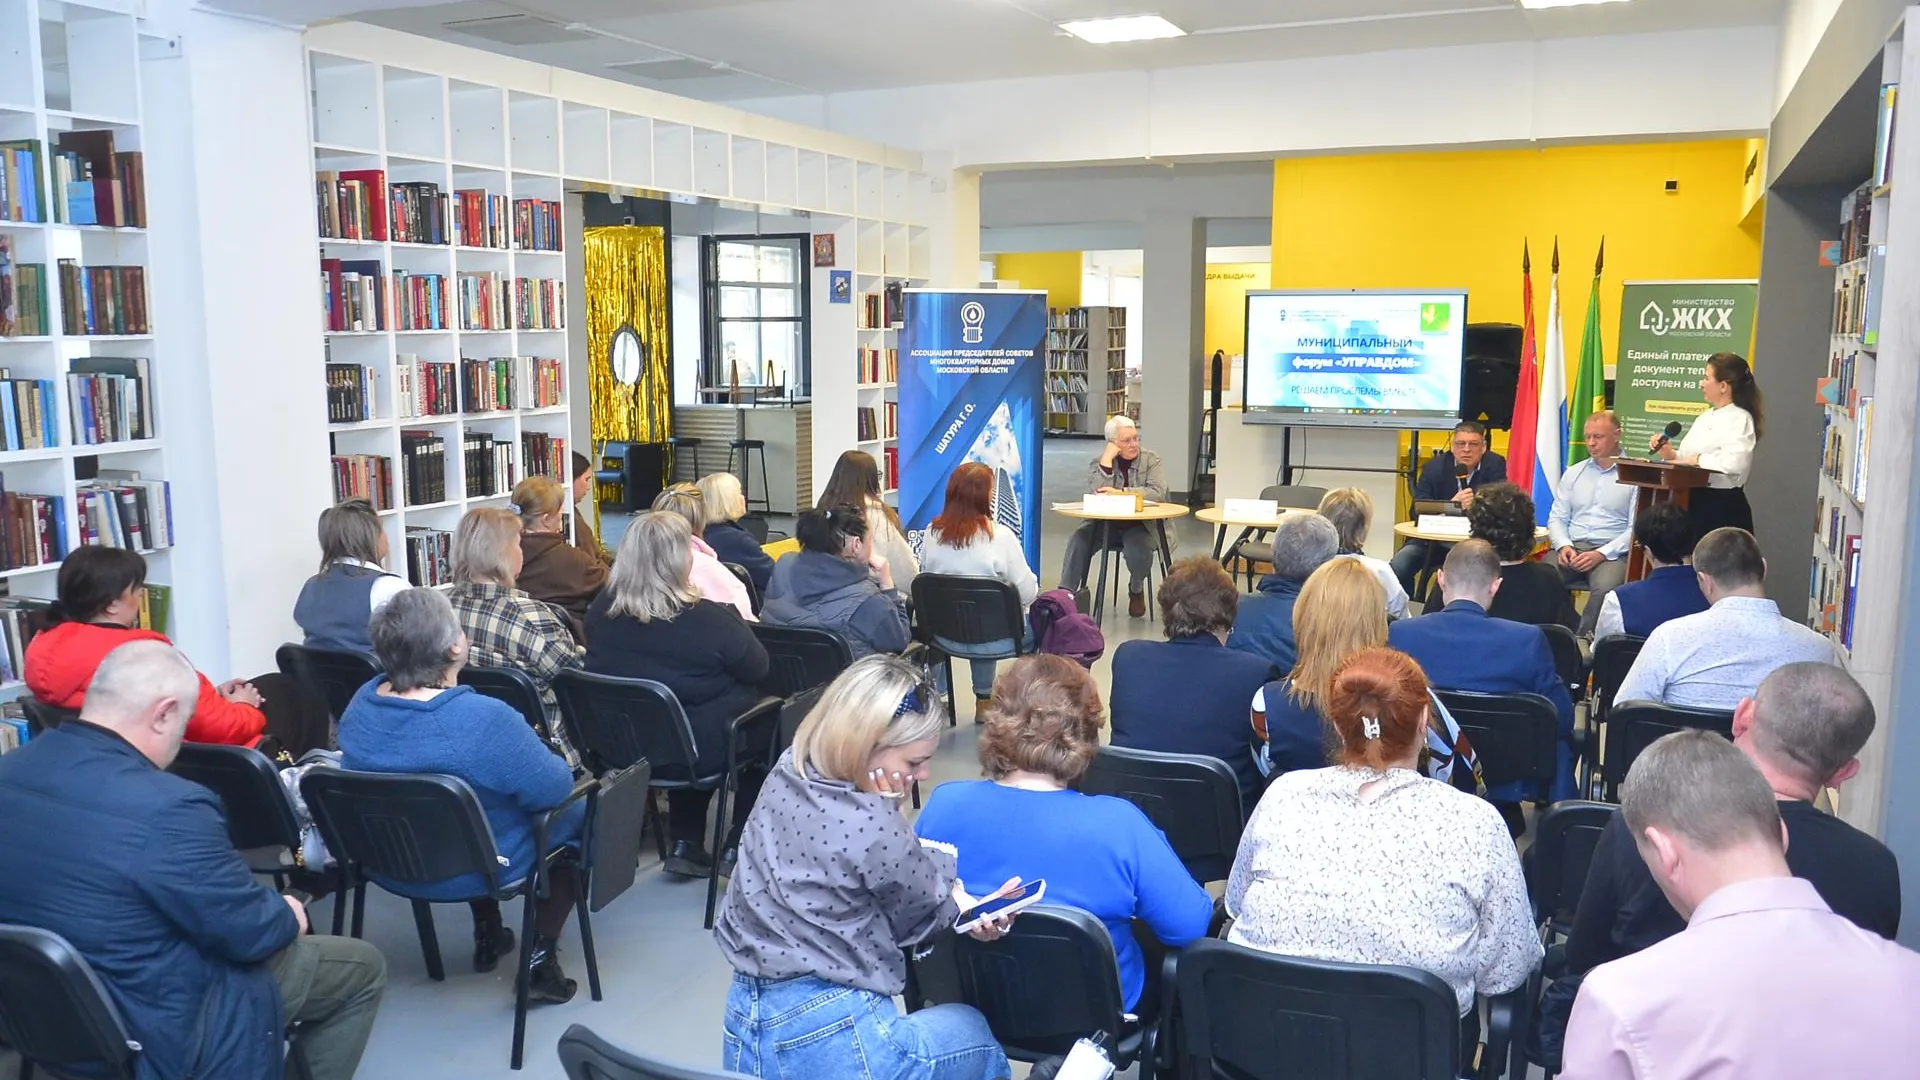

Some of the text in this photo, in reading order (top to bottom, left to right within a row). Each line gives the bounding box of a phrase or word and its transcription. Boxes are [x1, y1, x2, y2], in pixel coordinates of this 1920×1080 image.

[1670, 307, 1734, 330] ЖКХ
[1297, 336, 1413, 349] МУНИЦИПАЛЬНЫЙ
[910, 350, 953, 358] АССОЦИАЦИЯ
[953, 349, 1004, 358] ПРЕДСЕДАТЕЛЕЙ
[1627, 350, 1712, 361] Единый платеж
[992, 358, 1015, 366] ДОМОВ
[1292, 356, 1421, 370] форум «УПРАВДОМ»
[936, 366, 979, 374] МОСКОВСКОЙ
[1633, 365, 1705, 376] документ теп
[1631, 378, 1681, 390] доступен
[1683, 380, 1696, 389] на
[934, 403, 976, 455] ШАТУРА Г.О.
